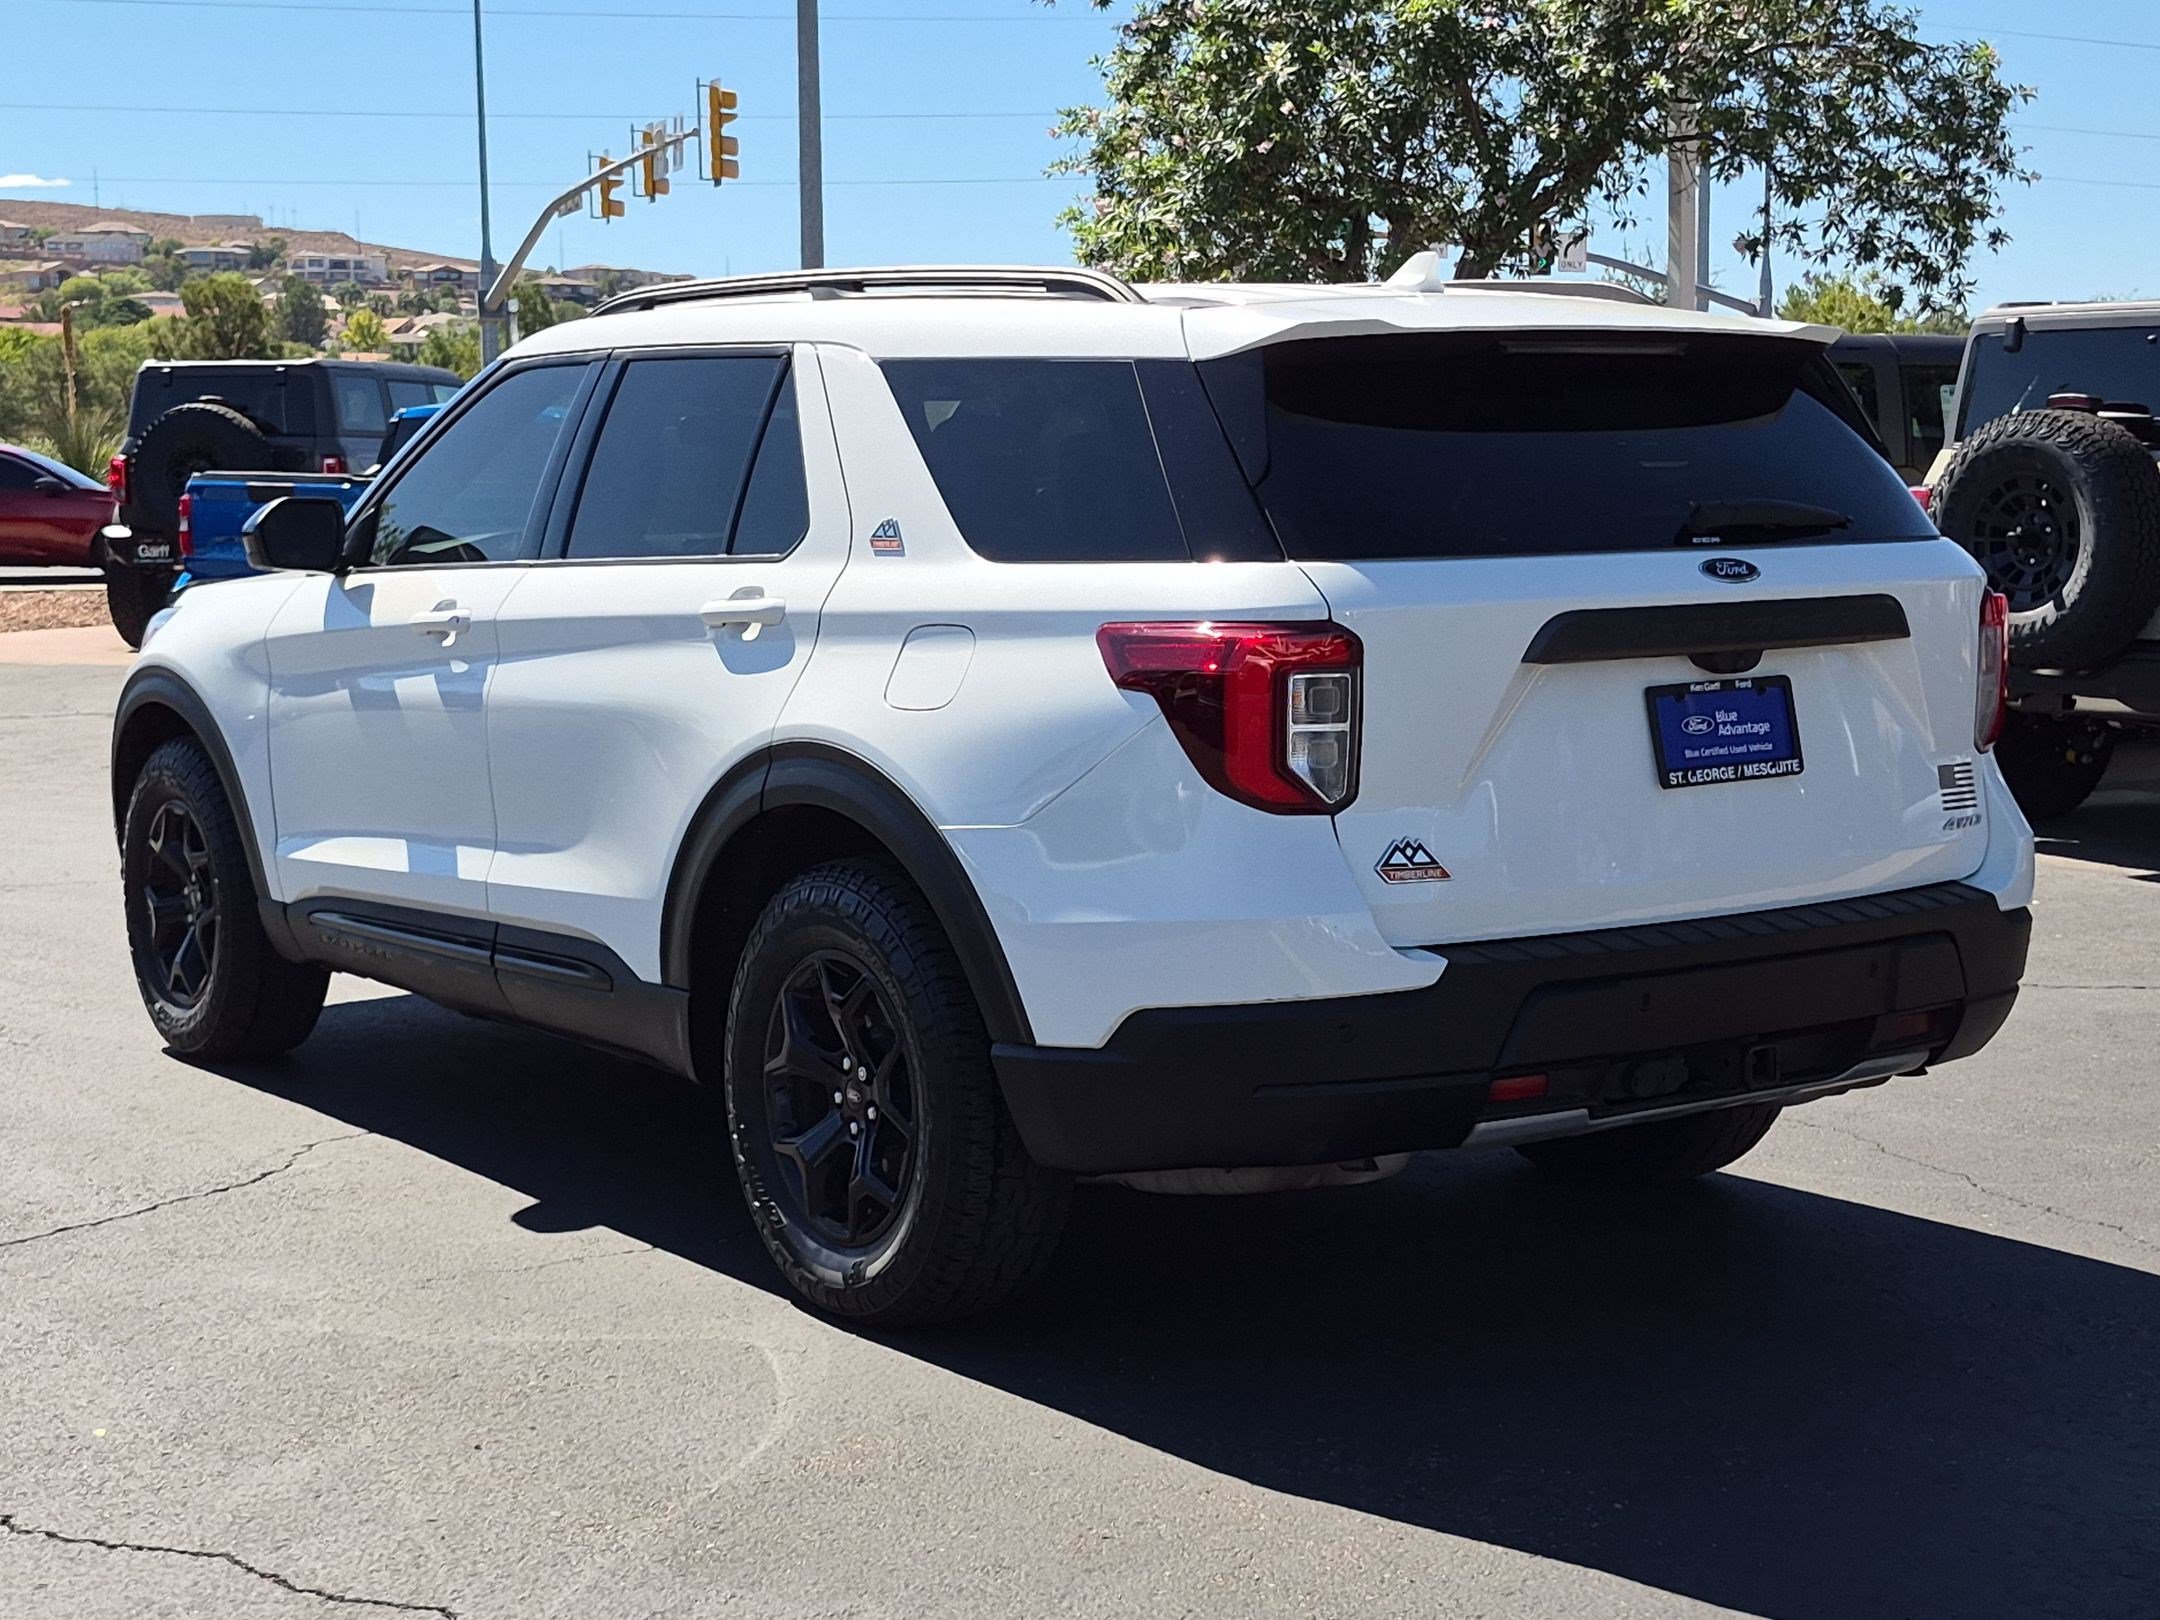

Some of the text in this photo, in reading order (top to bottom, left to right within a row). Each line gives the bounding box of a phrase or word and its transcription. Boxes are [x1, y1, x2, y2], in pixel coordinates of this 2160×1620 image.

[1561, 261, 1582, 269] ONLY
[1716, 561, 1749, 575] Ford
[1715, 710, 1738, 723] Blue
[1687, 718, 1708, 731] Ford
[1718, 721, 1771, 737] Advantage
[1669, 771, 1687, 785] ST.
[1688, 766, 1736, 783] GEORGE
[1744, 759, 1801, 777] MESQUITE
